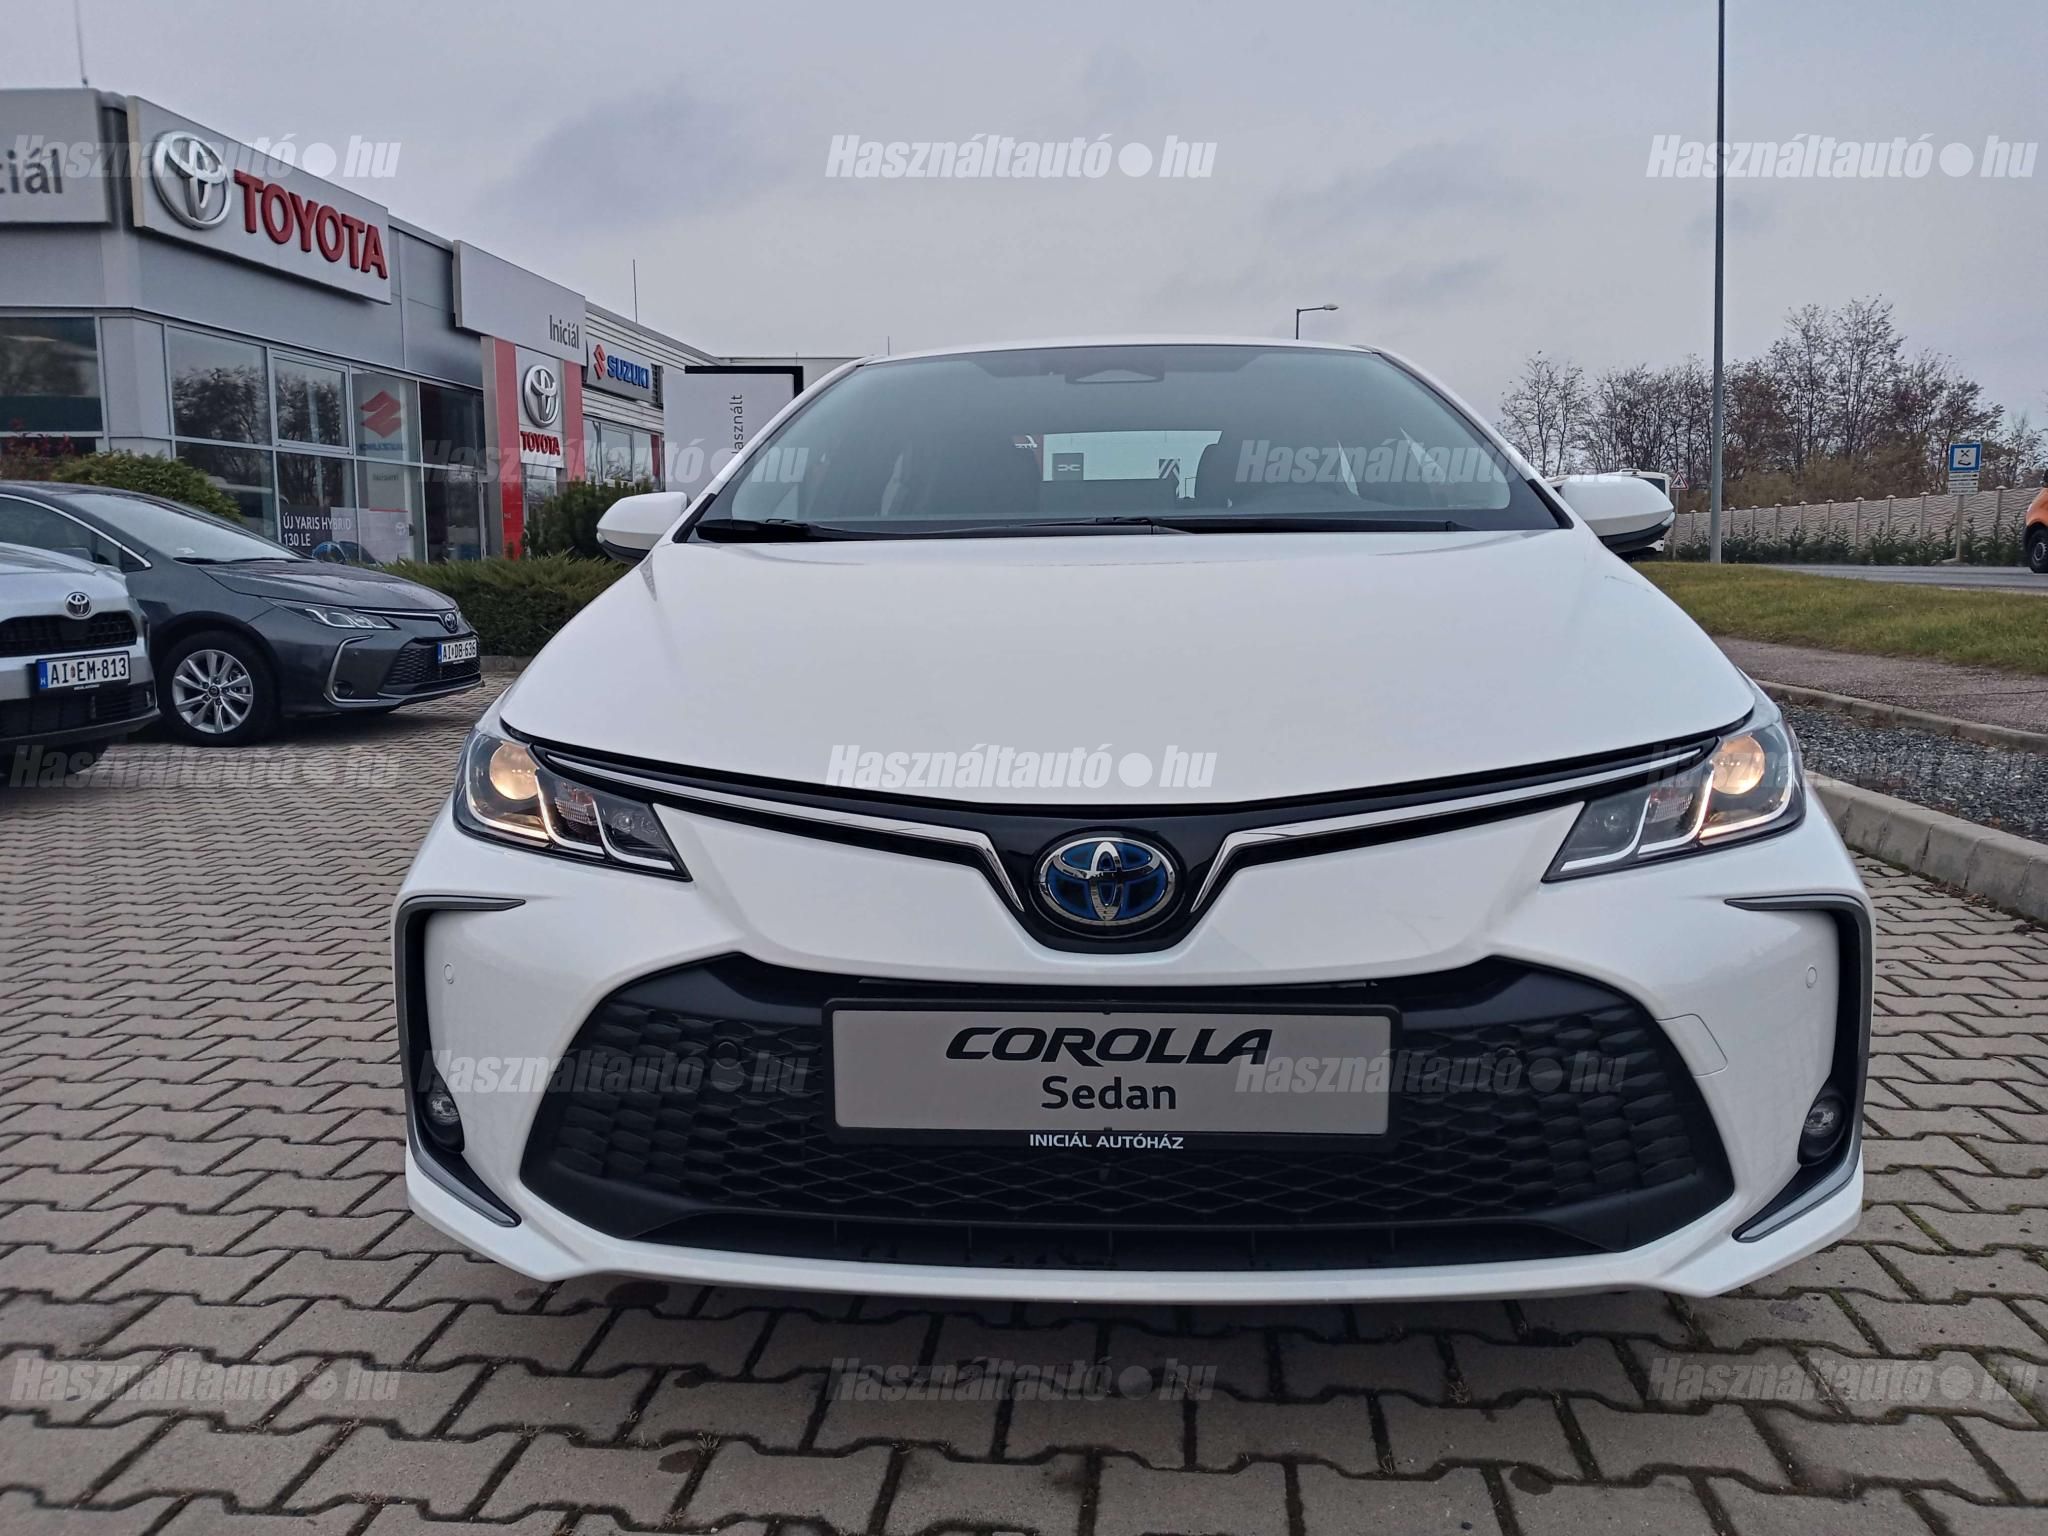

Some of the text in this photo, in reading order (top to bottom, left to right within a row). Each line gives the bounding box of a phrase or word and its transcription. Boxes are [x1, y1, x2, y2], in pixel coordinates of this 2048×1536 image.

[234, 169, 388, 279] TOYOTA
[549, 314, 580, 350] Iniciál
[606, 356, 649, 390] SUZUKI
[729, 394, 744, 454] asznált
[520, 430, 561, 456] TOYOTA
[283, 512, 351, 531] ÚJ YARIS HYBRID
[284, 533, 311, 546] 130 LE
[946, 1027, 1273, 1067] COROLLA
[1041, 1076, 1177, 1110] Sedan
[1029, 1131, 1184, 1150] INICIÁL AUTÓHÁZ
